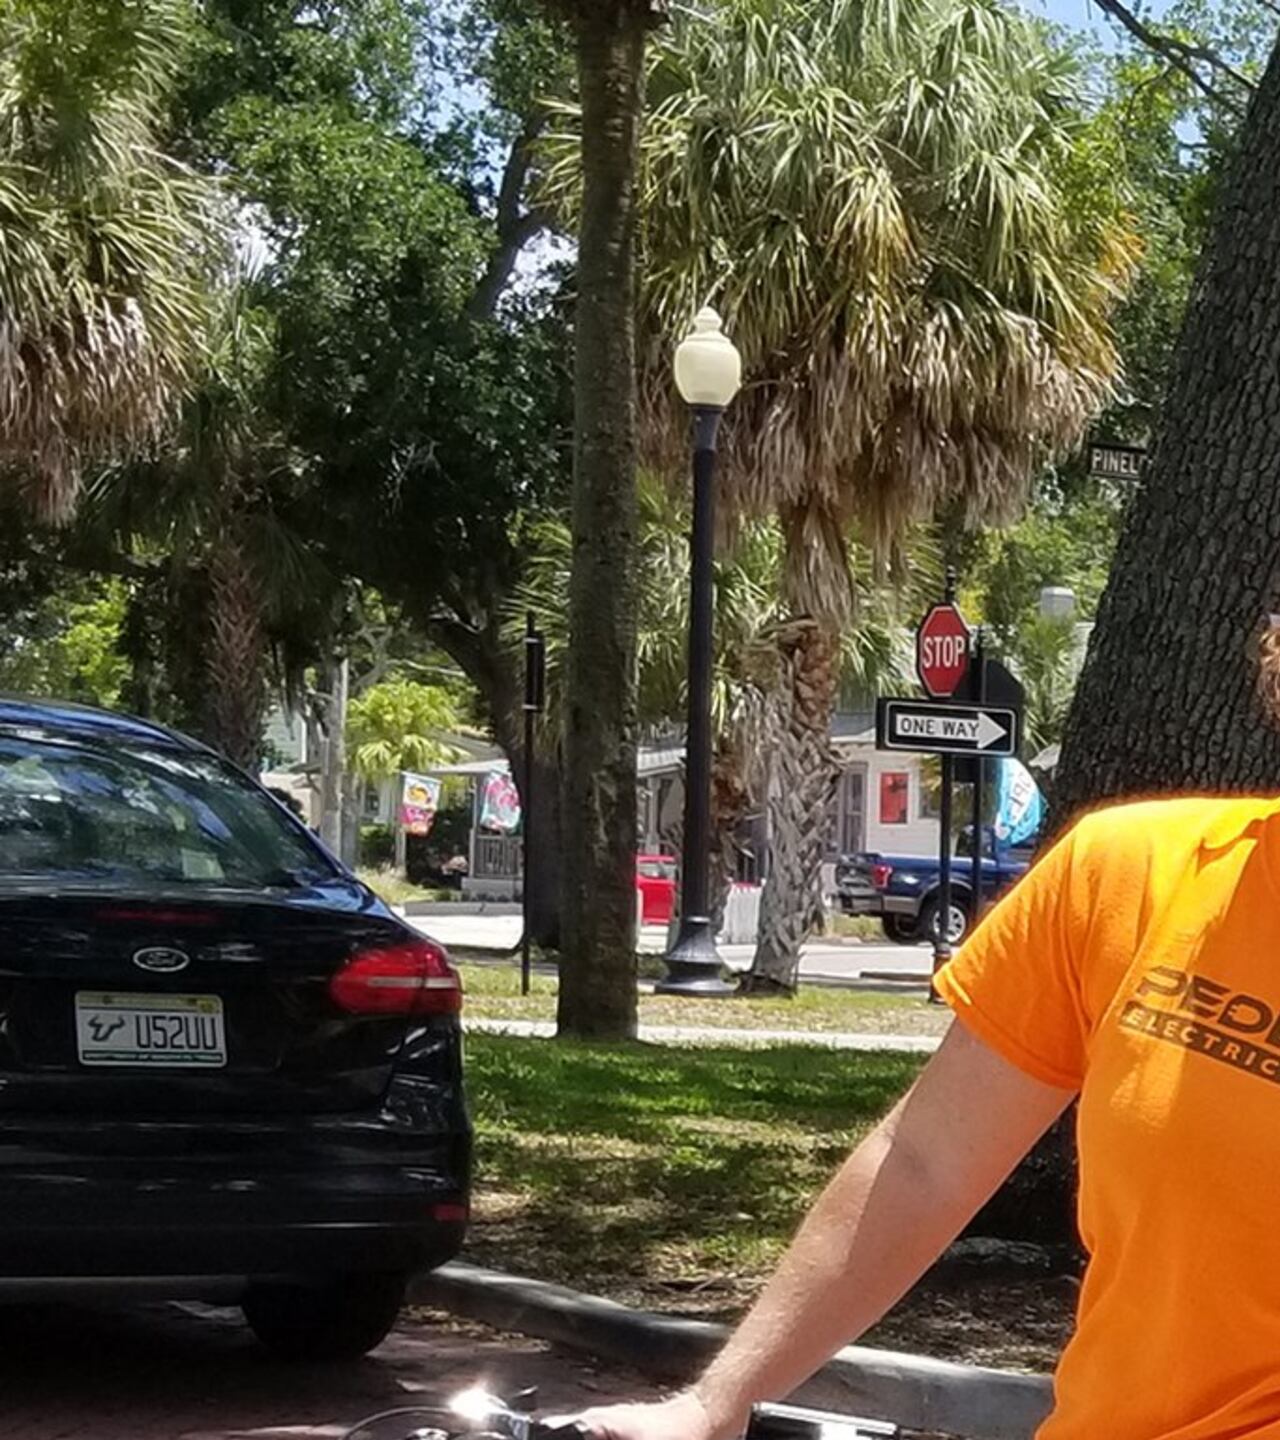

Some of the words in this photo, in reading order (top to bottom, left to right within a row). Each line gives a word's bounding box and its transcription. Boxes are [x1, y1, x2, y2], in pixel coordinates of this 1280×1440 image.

[923, 636, 966, 668] STOP
[900, 718, 935, 736] ONE
[942, 721, 979, 738] WAY
[1123, 1007, 1280, 1076] ELECTRIC
